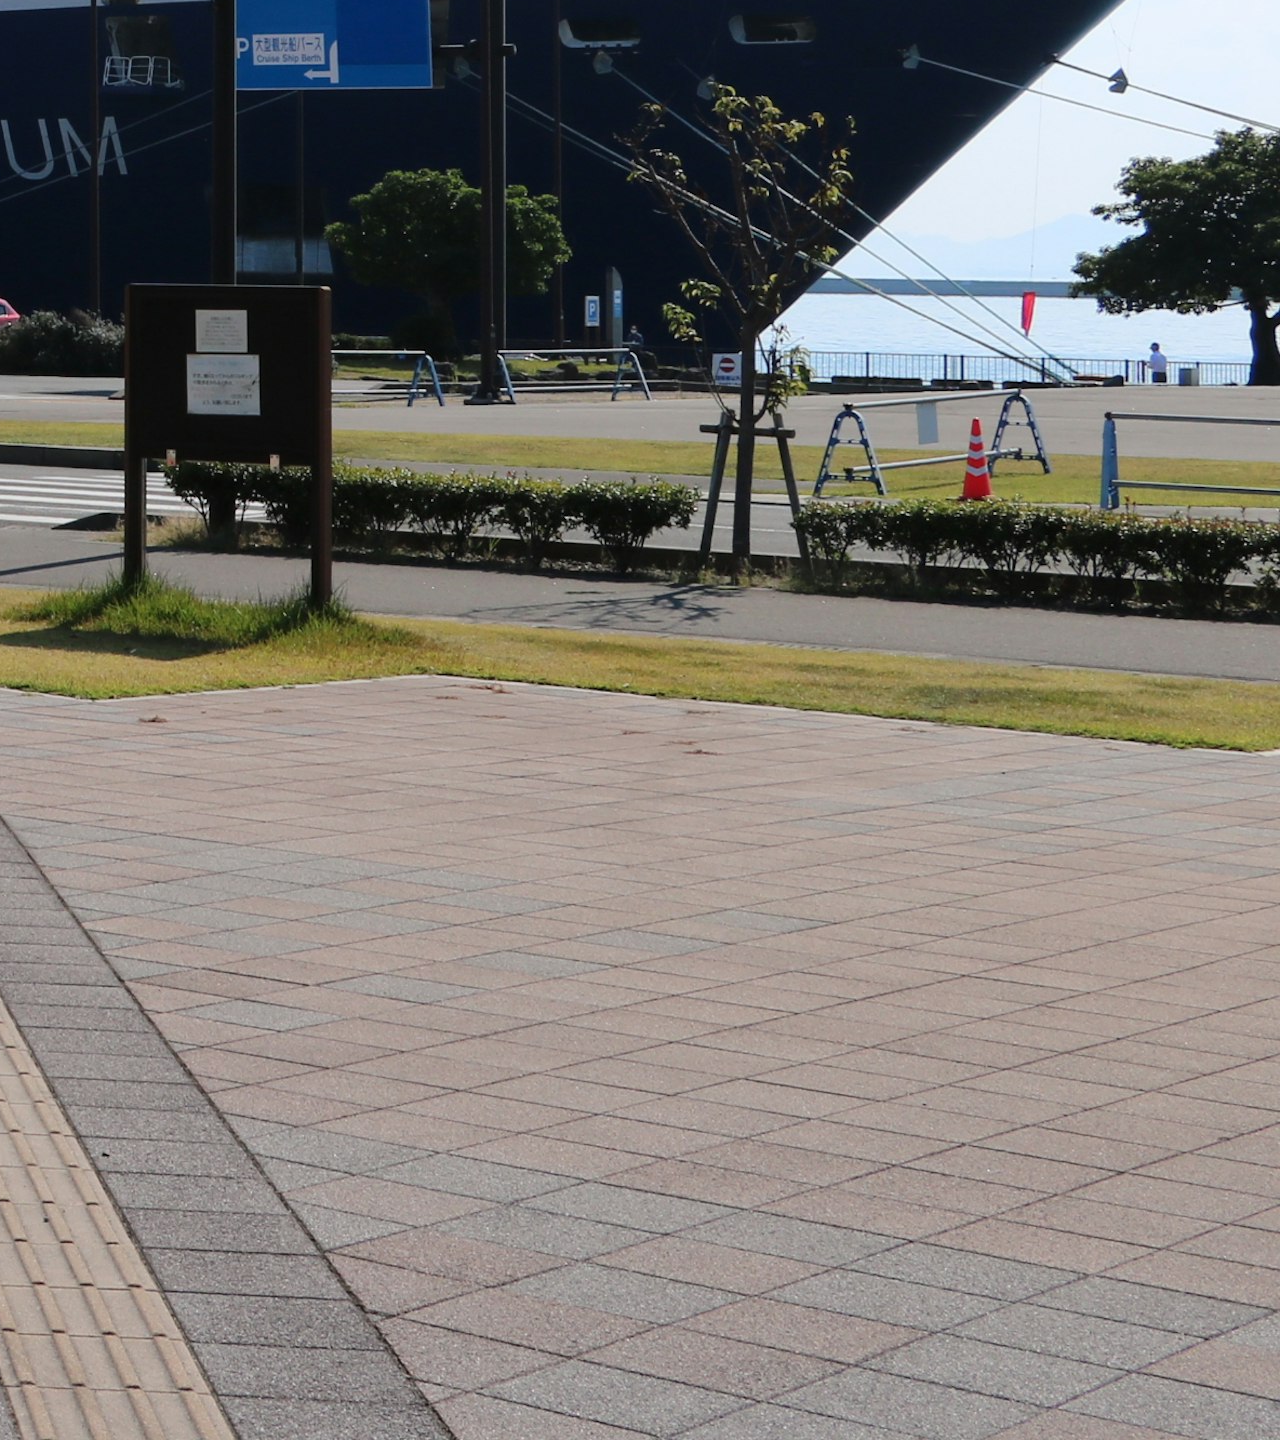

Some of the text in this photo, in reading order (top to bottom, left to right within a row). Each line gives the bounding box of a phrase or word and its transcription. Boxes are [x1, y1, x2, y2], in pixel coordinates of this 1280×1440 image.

[256, 53, 322, 64] Cruise Ship Berth
